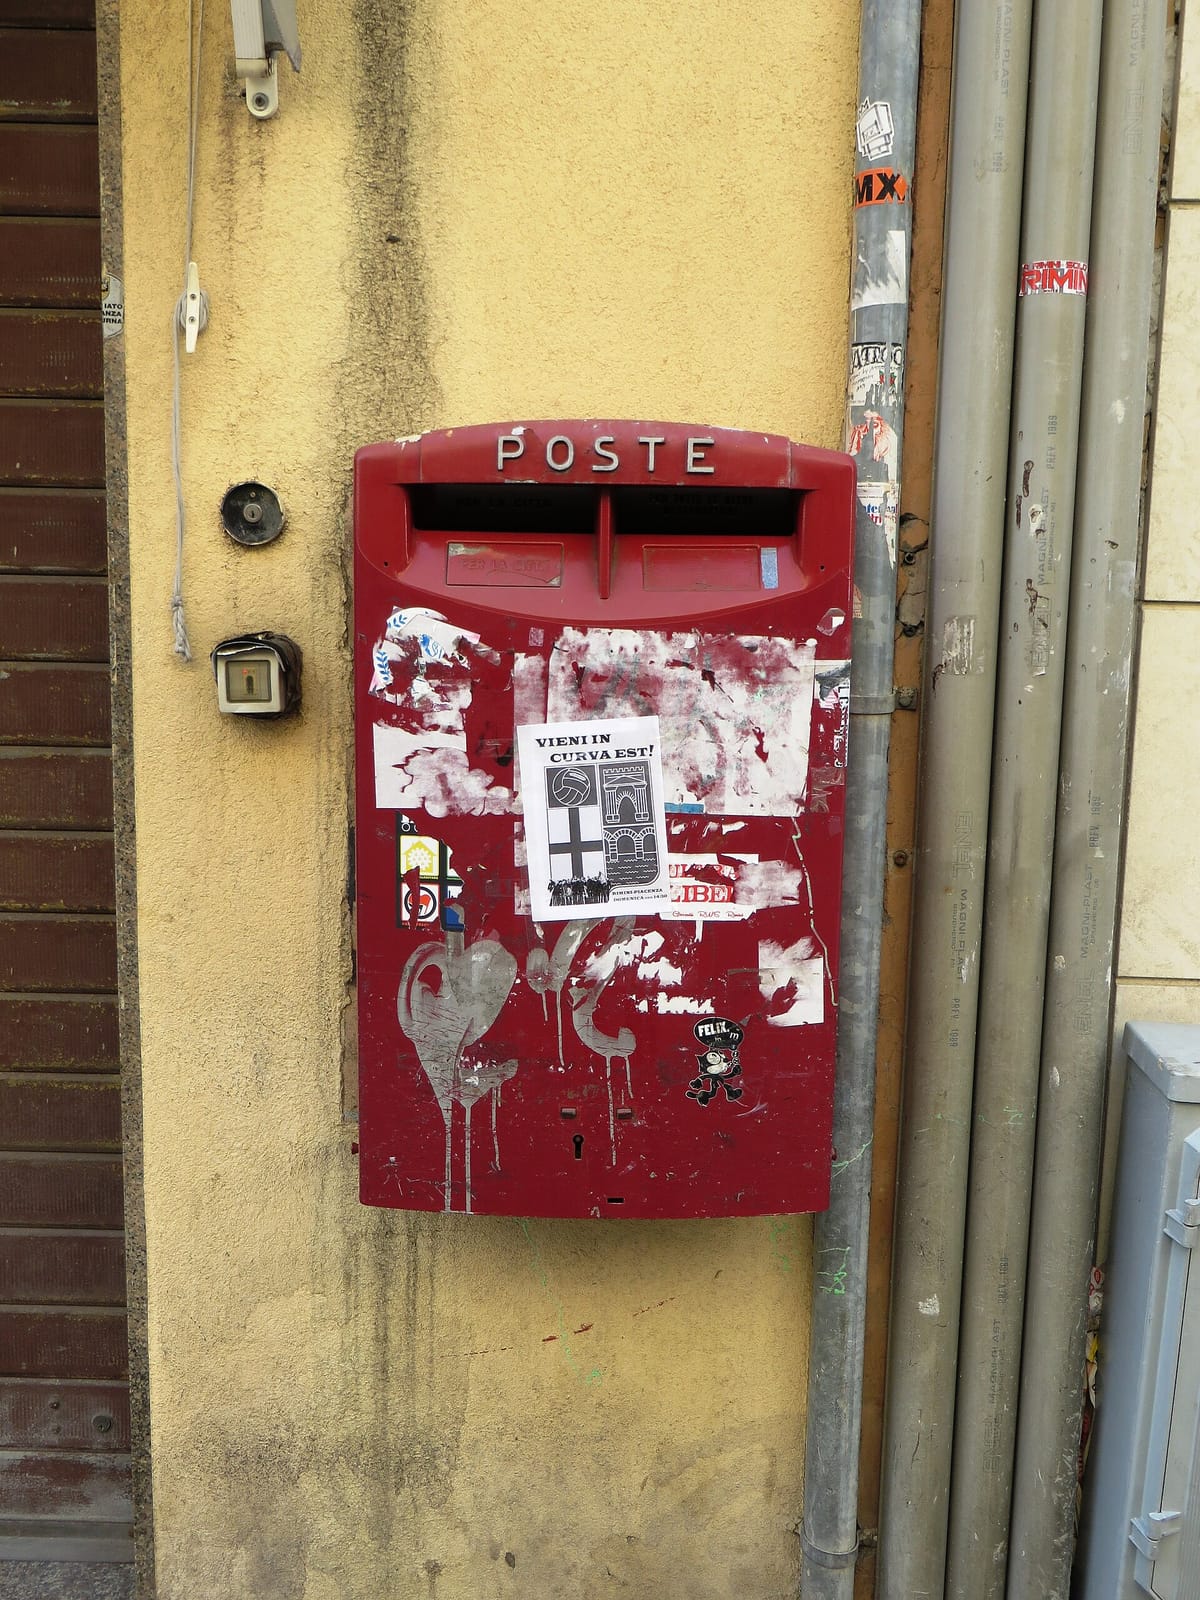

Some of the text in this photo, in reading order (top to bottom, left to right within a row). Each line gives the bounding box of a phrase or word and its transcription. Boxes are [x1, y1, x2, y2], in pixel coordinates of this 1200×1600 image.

[1001, 0, 1013, 97] AGNI-PLAST
[498, 436, 715, 473] POSTE
[536, 733, 611, 748] VIENI IN
[550, 745, 654, 763] CURVA EST!
